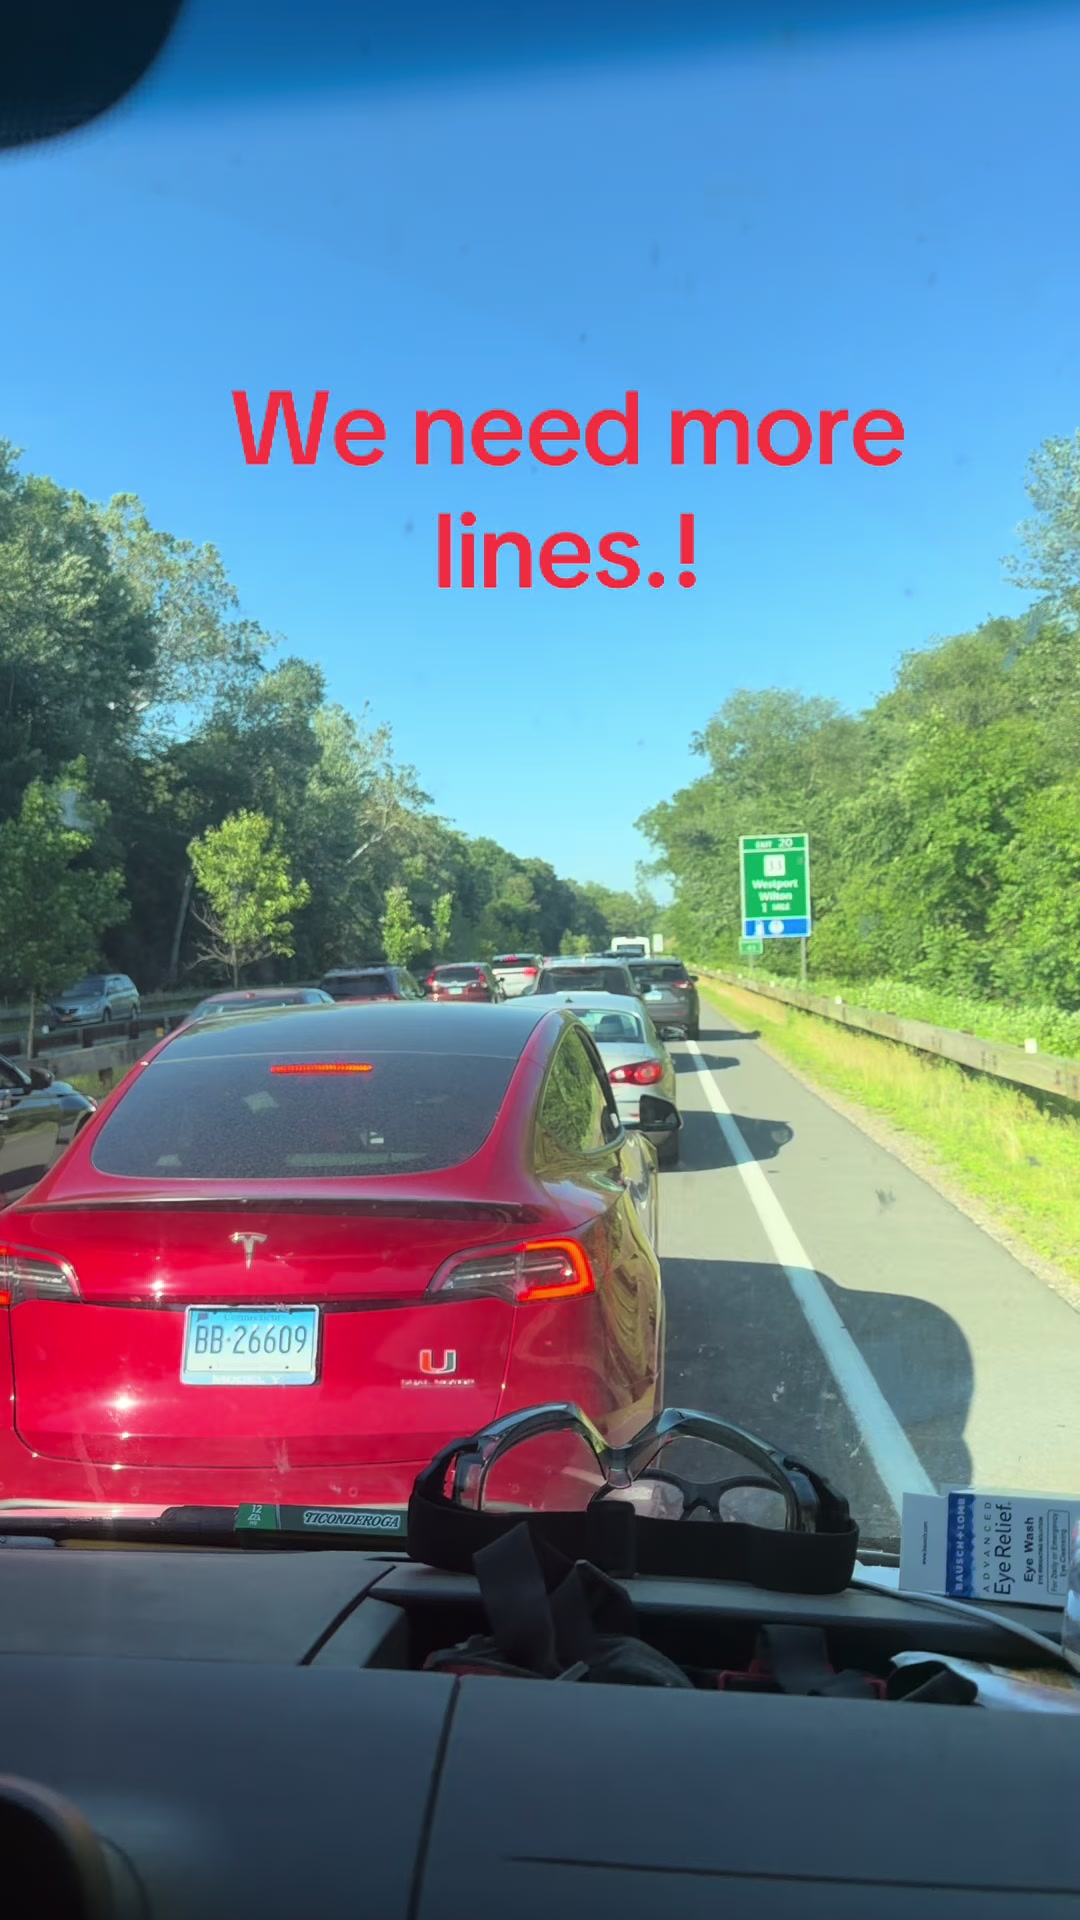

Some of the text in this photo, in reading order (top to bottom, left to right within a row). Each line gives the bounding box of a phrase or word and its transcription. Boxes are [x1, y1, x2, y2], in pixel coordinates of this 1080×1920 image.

[778, 838, 793, 848] 20
[752, 879, 799, 891] Westport
[758, 891, 793, 902] Wilton
[761, 902, 768, 913] 1
[420, 1349, 456, 1374] U
[252, 1504, 263, 1514] 12
[303, 1510, 401, 1528] TICONDEROGA
[983, 1502, 992, 1593] ADVANCED
[1024, 1517, 1036, 1582] Eye Wash
[994, 1561, 1015, 1595] Eye
[1051, 1561, 1059, 1580] Daily
